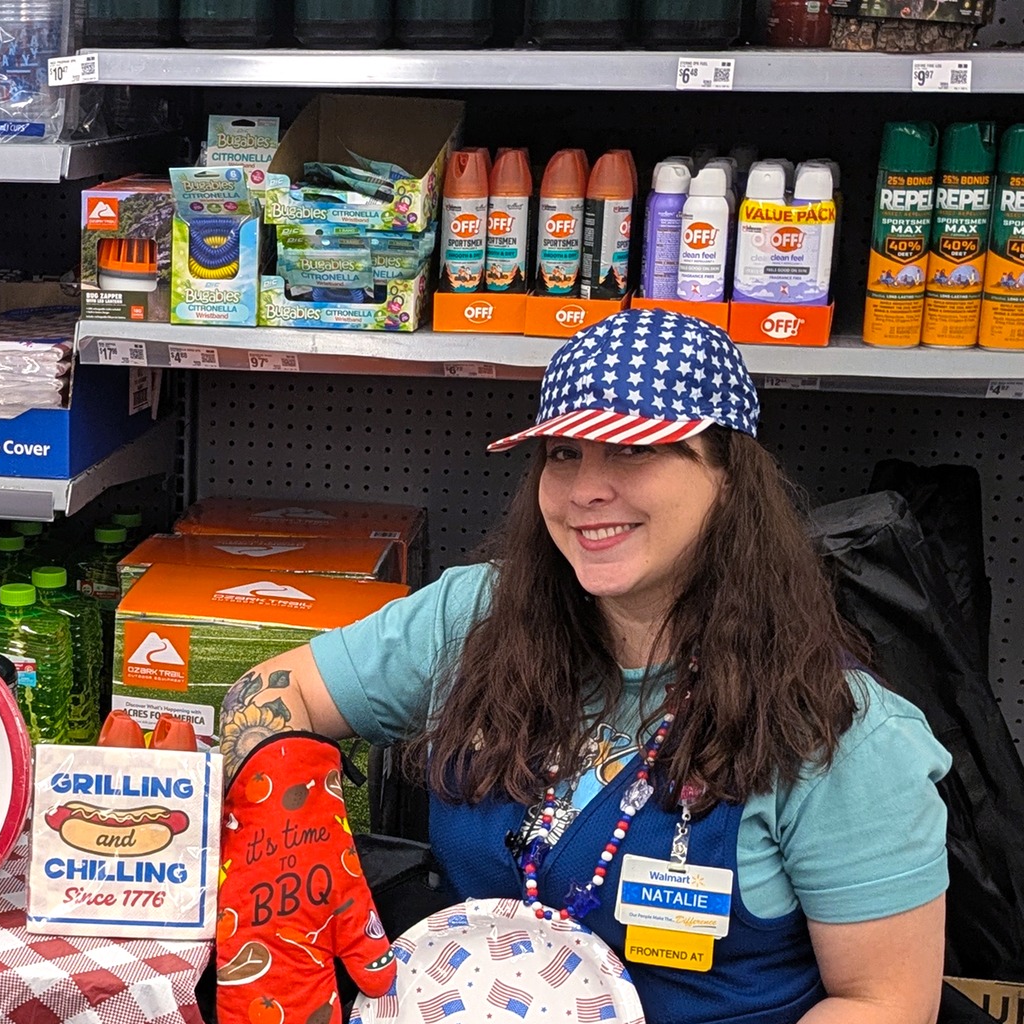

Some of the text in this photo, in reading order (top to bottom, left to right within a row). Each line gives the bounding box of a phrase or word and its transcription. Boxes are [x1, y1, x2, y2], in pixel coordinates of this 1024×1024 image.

[217, 132, 272, 150] Bugables
[212, 152, 272, 162] CITRONELLA
[182, 178, 235, 192] Bugables
[907, 176, 933, 186] BONUS
[961, 175, 990, 185] BONUS
[182, 191, 240, 200] CITRONELLA
[880, 188, 934, 211] REPEL
[936, 187, 991, 211] REPEL
[271, 203, 327, 220] Bugables
[745, 206, 835, 222] VALUE PACK
[451, 219, 480, 233] OFF!
[546, 219, 575, 233] OFF!
[937, 217, 986, 225] SPORTSMEN
[890, 225, 922, 233] MAX
[945, 224, 977, 233] MAX
[684, 229, 717, 245] OFF!
[771, 233, 804, 248] OFF!
[889, 241, 921, 251] 40%
[943, 240, 975, 251] 40%
[682, 251, 716, 259] clean feel
[300, 258, 355, 273] Bugables
[301, 273, 360, 282] CITRONELLA
[184, 288, 241, 304] Bugables
[188, 305, 237, 313] CITRONELLA
[266, 303, 321, 320] Bugables
[325, 310, 372, 318] CITRONELLA
[464, 306, 493, 320] OFF!
[556, 310, 585, 324] OFF!
[3, 440, 51, 457] Cover
[159, 669, 184, 678] TRAIL
[164, 706, 190, 714] Happening
[50, 772, 193, 799] GRILLING
[96, 829, 136, 848] and
[246, 819, 330, 865] it's time
[279, 854, 296, 871] TO
[44, 858, 188, 884] CHILLING
[650, 871, 690, 884] Walmart
[63, 887, 166, 908] Since 1776
[249, 864, 333, 927] BBQ
[641, 887, 708, 908] NATALIE
[676, 915, 717, 927] Difference
[630, 946, 704, 962] FRONTEND AT
